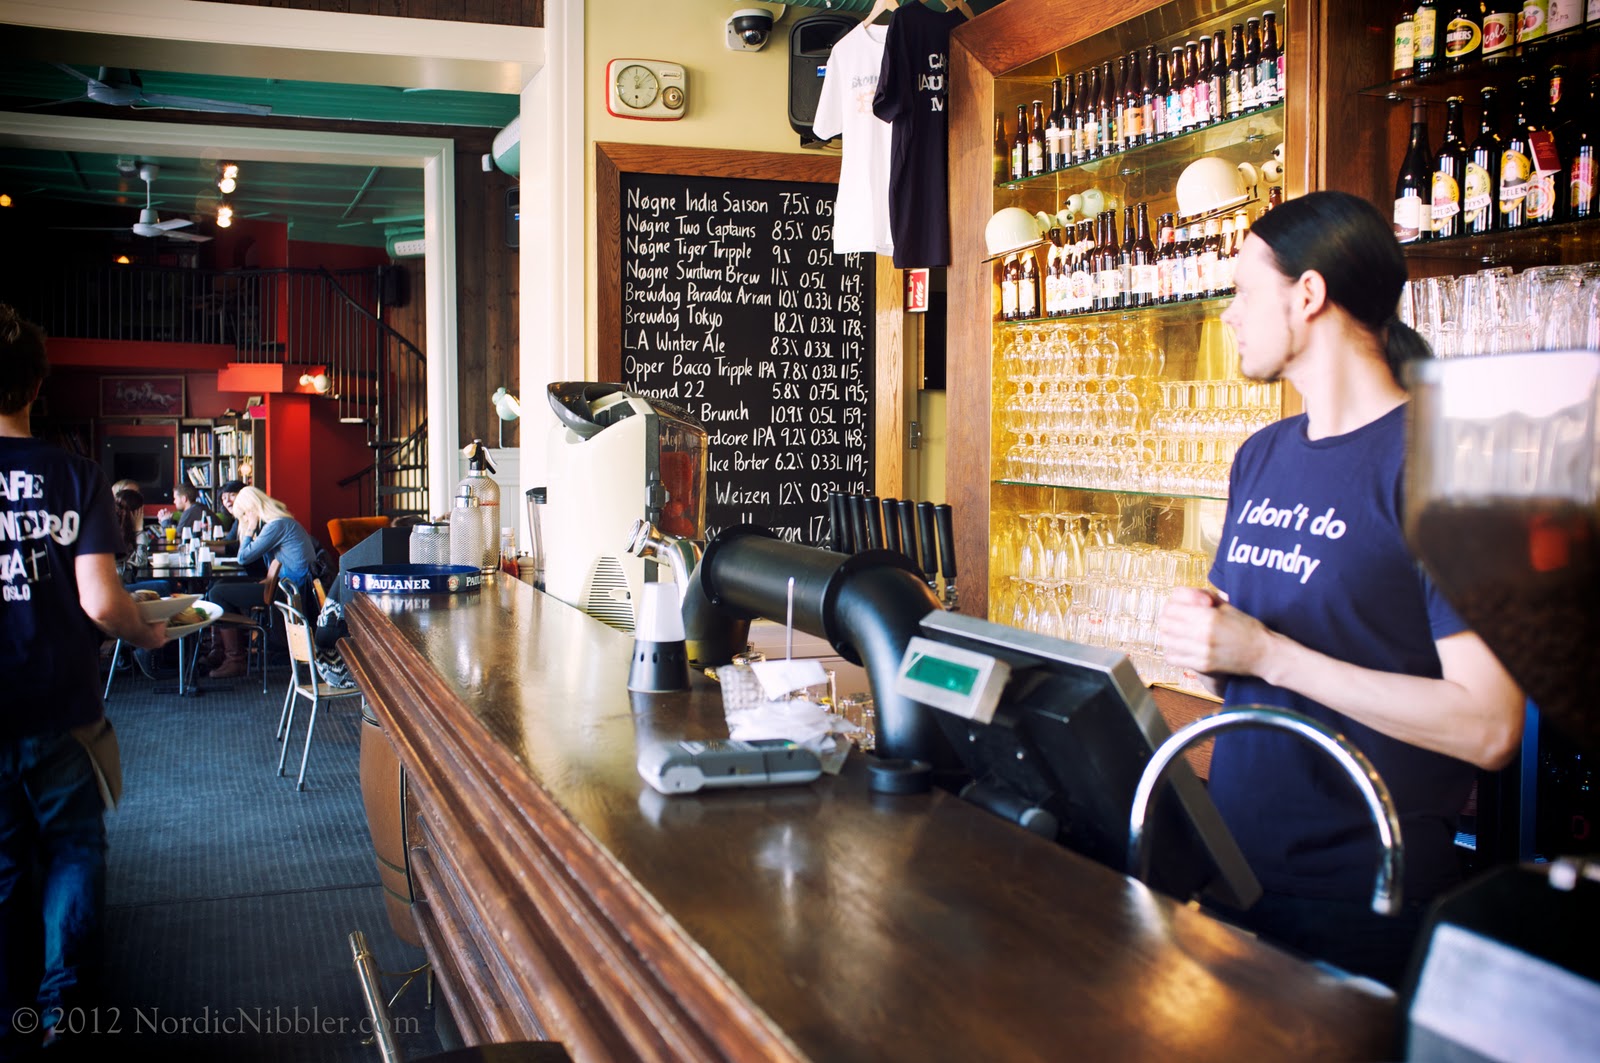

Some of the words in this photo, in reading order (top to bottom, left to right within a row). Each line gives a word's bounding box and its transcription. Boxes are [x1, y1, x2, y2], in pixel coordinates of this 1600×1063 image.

[627, 187, 676, 217] Nøgne
[686, 188, 718, 212] India
[722, 191, 769, 213] Saison
[627, 213, 670, 241] Nøgne
[675, 215, 700, 236] Two
[706, 216, 756, 243] Captains
[771, 220, 804, 241] 8.5%
[626, 235, 670, 261] Nøgne
[674, 238, 708, 263] Tiger
[709, 240, 752, 267] Tripple
[626, 259, 669, 288] Nøgne
[726, 265, 760, 285] Brew
[625, 281, 681, 311] Brewdog
[687, 282, 732, 304] Paradox
[736, 285, 772, 306] Arran
[625, 305, 680, 332] Brewdog
[686, 304, 723, 334] Tokyo
[774, 312, 804, 333] 18.2%
[656, 331, 699, 352] Winter
[702, 332, 726, 353] Ale
[770, 336, 798, 356] 8.3%
[625, 355, 665, 382] Opper
[672, 354, 711, 376] Bacco
[714, 356, 753, 386] Tripple
[758, 361, 777, 379] IPA
[625, 381, 680, 399] Almond
[684, 380, 705, 398] 22
[772, 382, 800, 400] 5.8%
[701, 400, 749, 422] Brunch
[809, 406, 837, 424] 0.5L
[707, 428, 749, 446] rdcore
[753, 425, 776, 447] IPA
[706, 452, 729, 473] lice
[734, 450, 770, 472] Porter
[775, 452, 804, 471] 6.2%
[811, 453, 843, 471] 0.33L
[0, 470, 44, 501] AFE
[715, 481, 770, 505] Weizen
[0, 510, 80, 546] NDRO
[1237, 499, 1252, 524] I
[1247, 498, 1310, 531] don't
[1309, 507, 1347, 539] do
[1227, 536, 1321, 584] Laundry
[2, 584, 31, 602] OSLO
[365, 578, 431, 590] PAULANER
